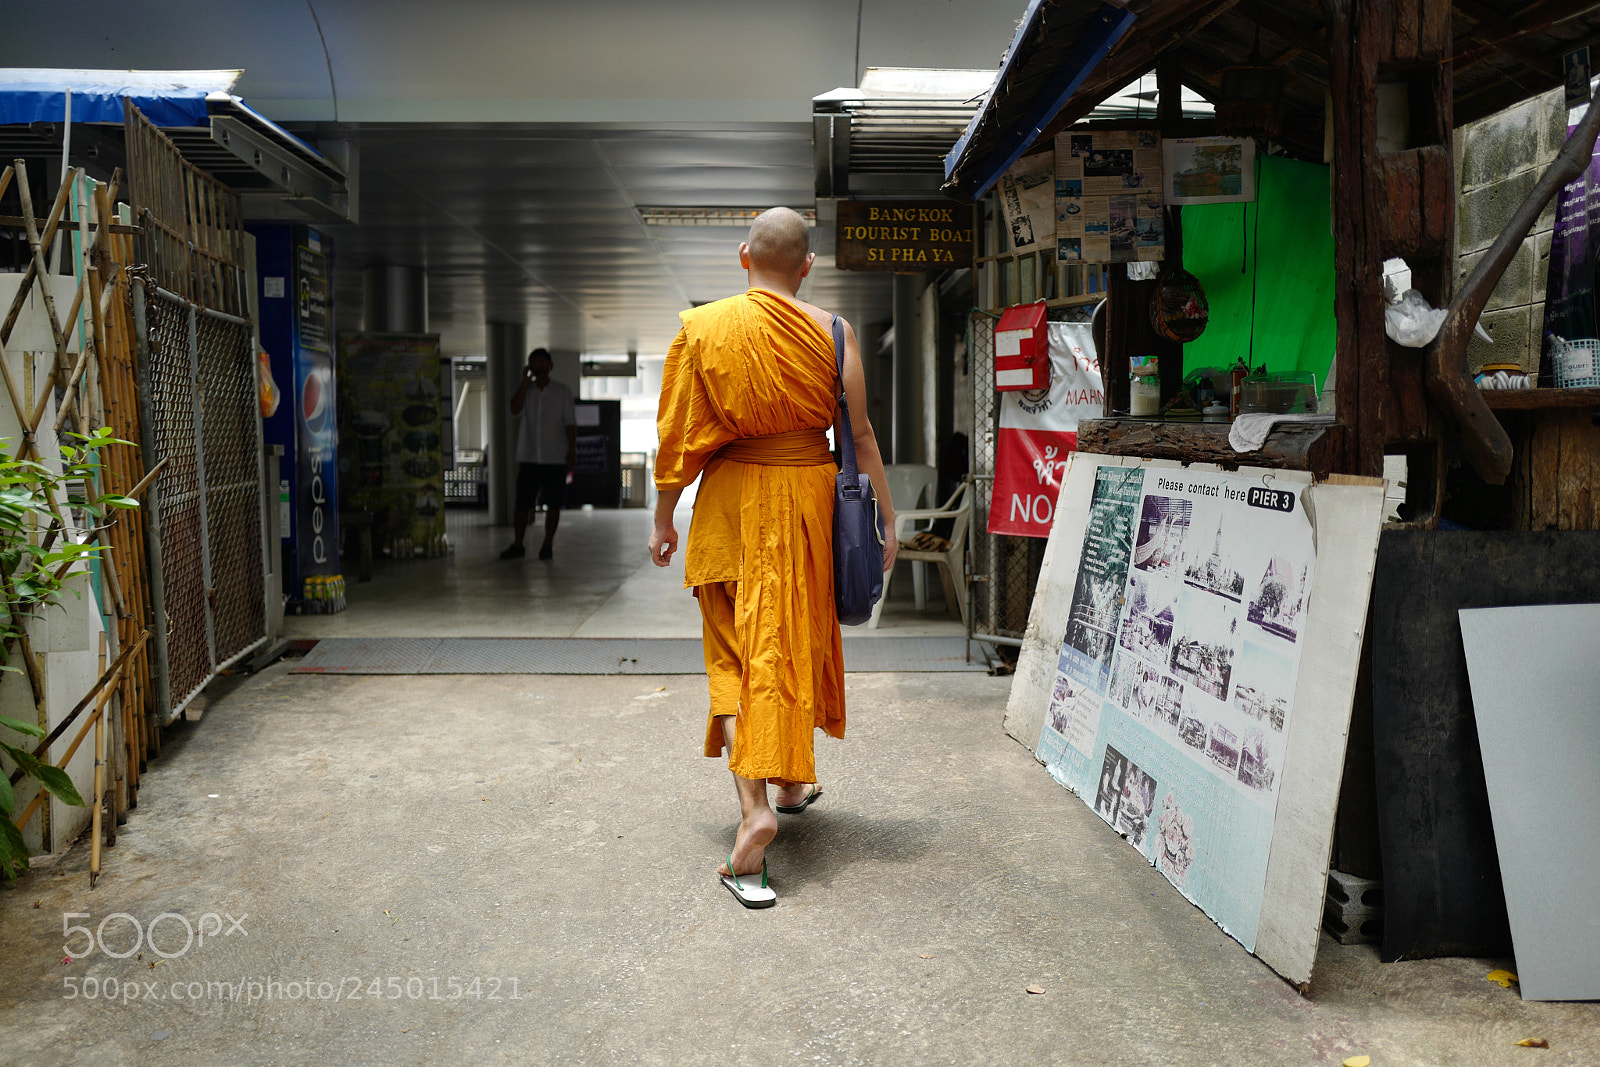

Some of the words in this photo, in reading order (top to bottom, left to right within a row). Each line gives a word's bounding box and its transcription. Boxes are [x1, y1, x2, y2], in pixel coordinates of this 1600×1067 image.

[869, 207, 953, 222] BANGKOK
[843, 226, 921, 241] TOURIST
[930, 228, 974, 242] BOAT
[868, 248, 885, 261] SI
[891, 248, 928, 262] PHA
[932, 249, 955, 262] YA
[1158, 478, 1184, 491] Please
[1188, 483, 1219, 497] contact
[1225, 486, 1246, 501] here
[1252, 490, 1278, 507] PIER
[1282, 494, 1289, 509] 3
[308, 447, 327, 564] pepsi
[1010, 493, 1053, 524] NO
